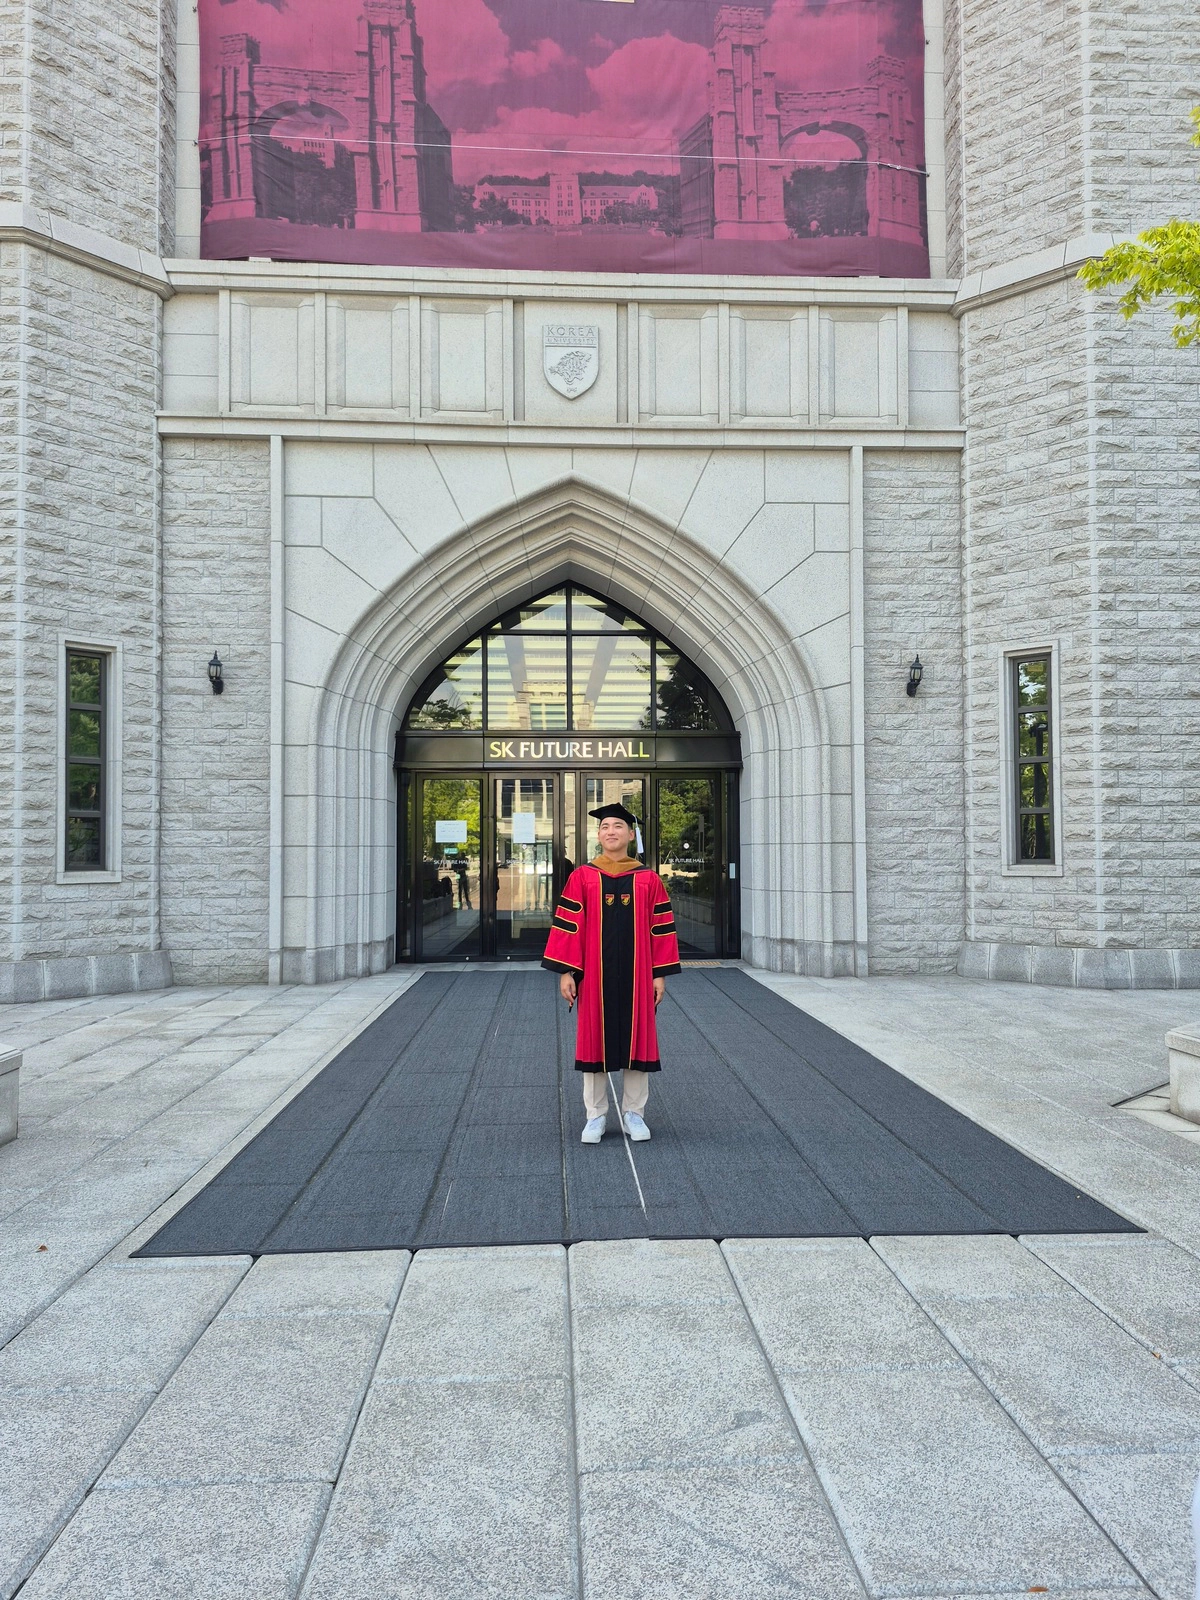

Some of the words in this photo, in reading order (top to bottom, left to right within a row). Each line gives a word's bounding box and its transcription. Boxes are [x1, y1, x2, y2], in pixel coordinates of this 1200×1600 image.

[547, 326, 595, 337] KOREA
[489, 741, 516, 758] SK
[519, 741, 594, 759] FUTURE
[597, 741, 650, 758] HALL
